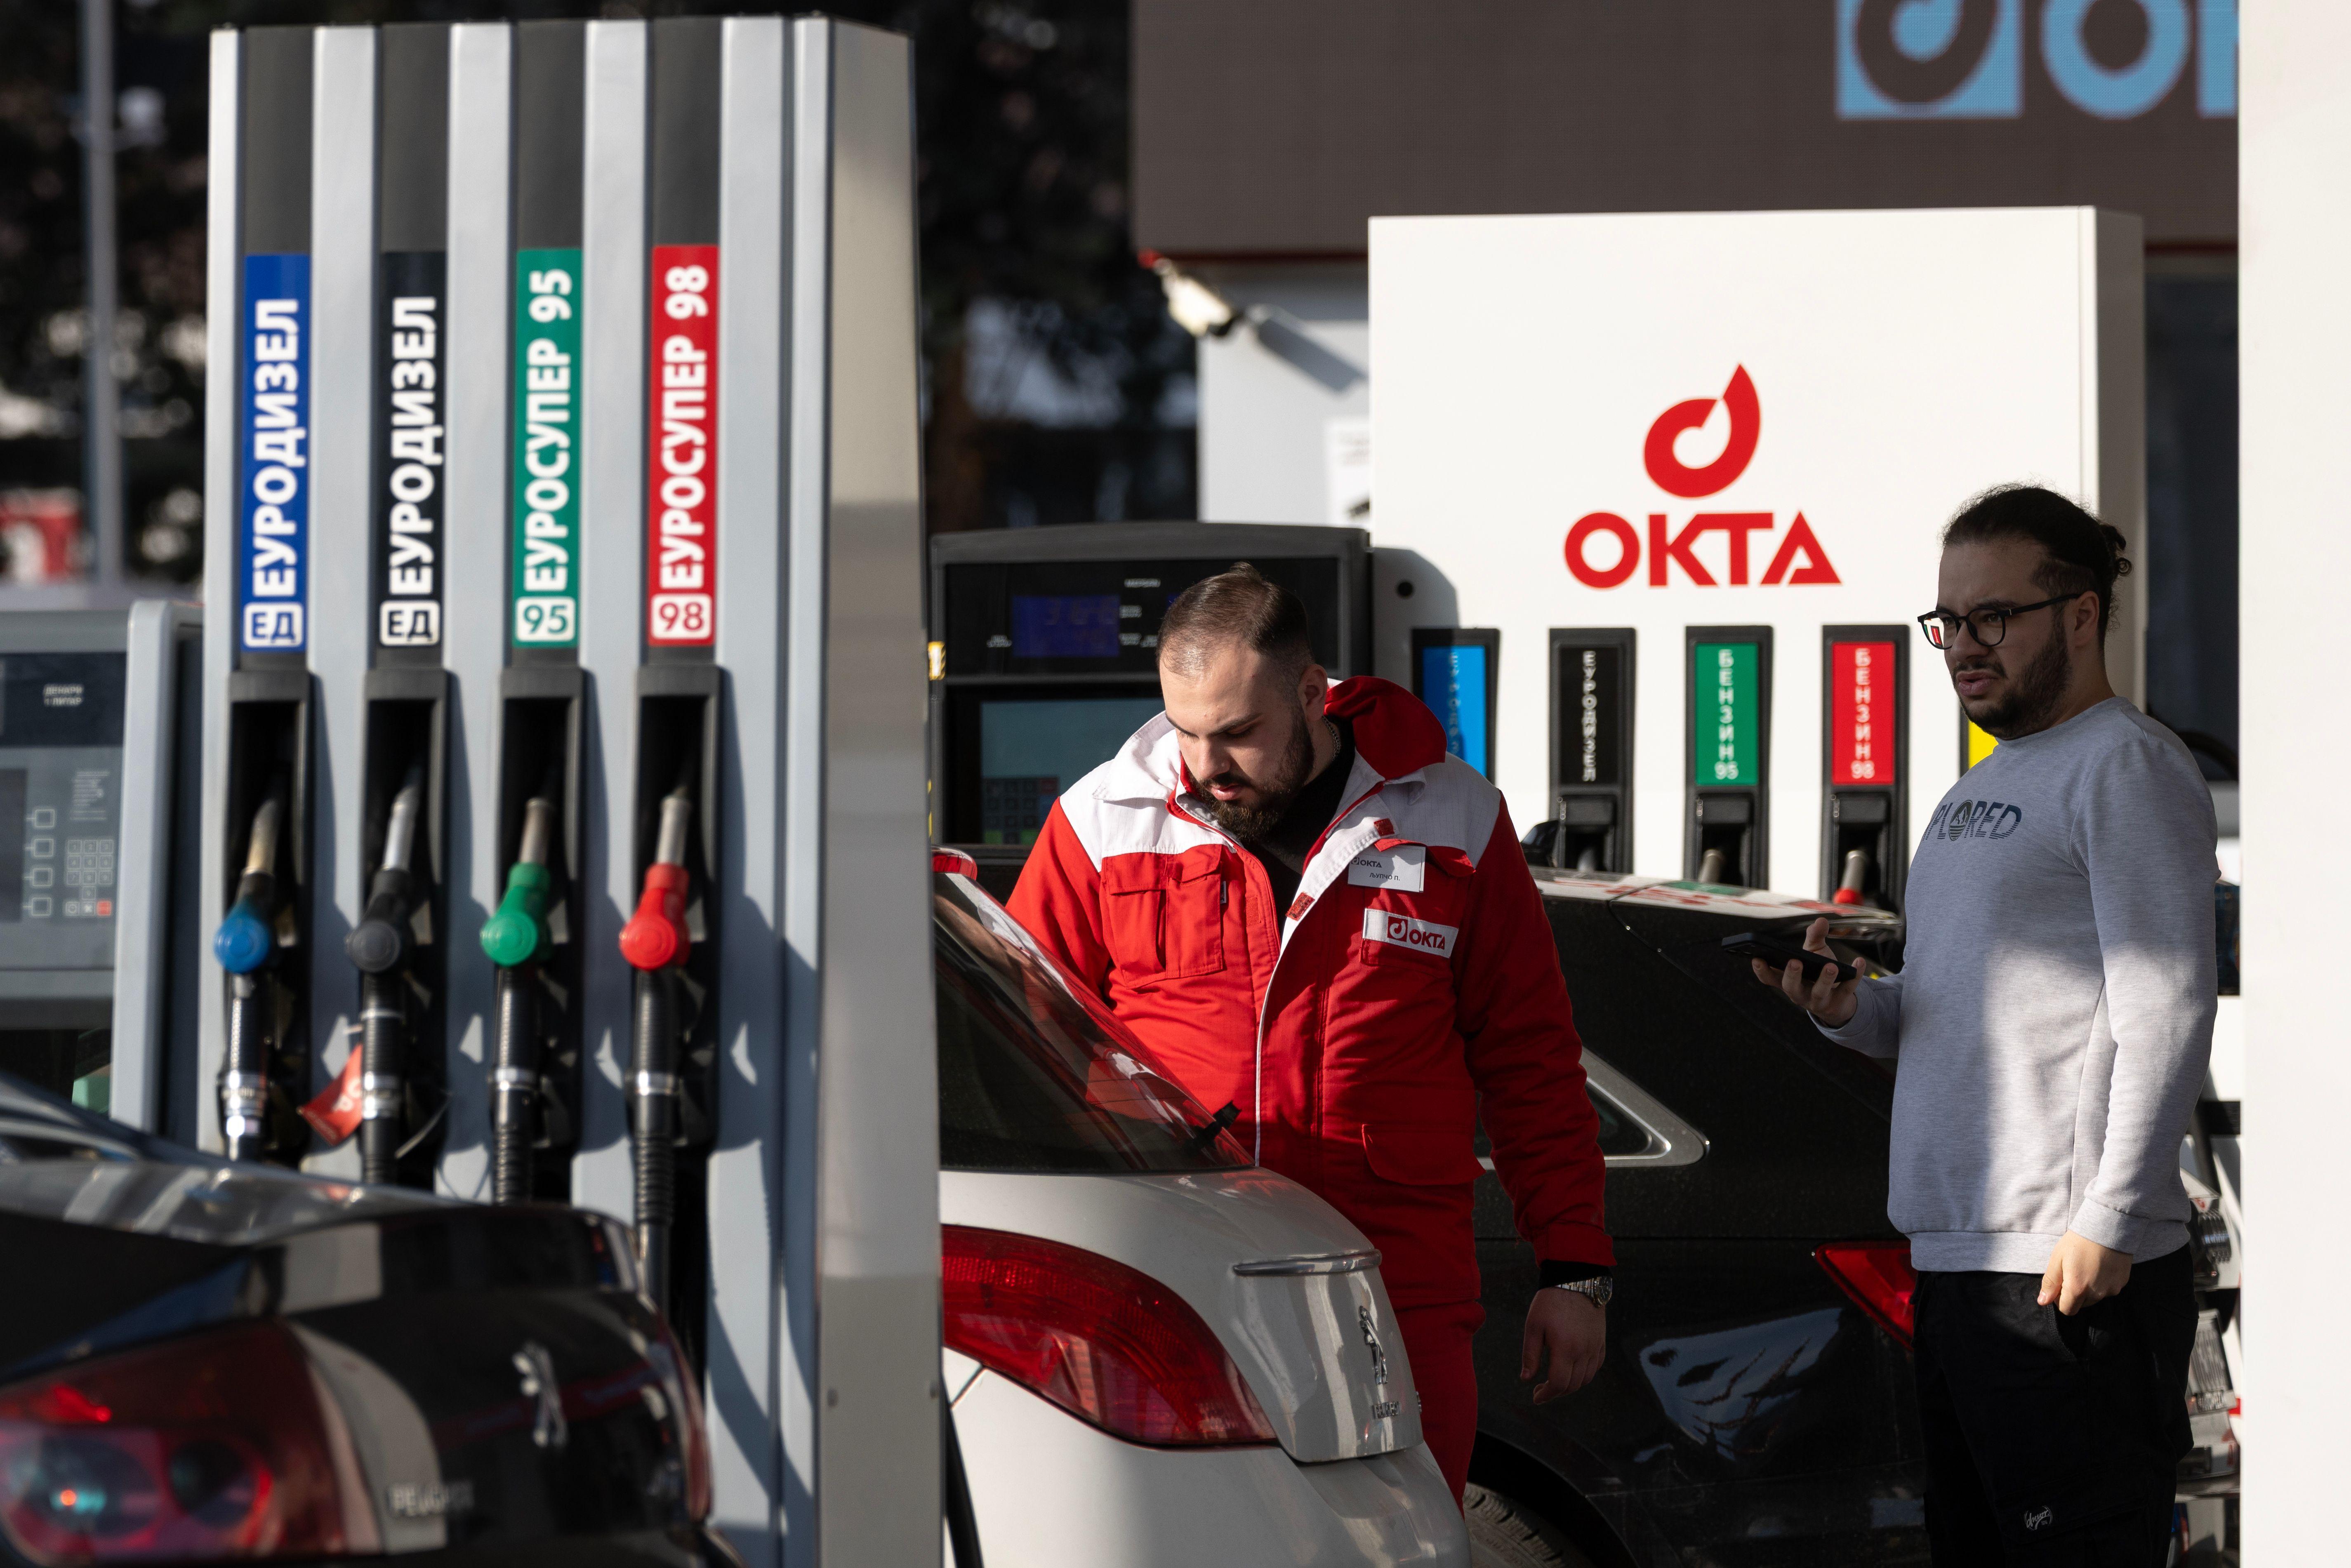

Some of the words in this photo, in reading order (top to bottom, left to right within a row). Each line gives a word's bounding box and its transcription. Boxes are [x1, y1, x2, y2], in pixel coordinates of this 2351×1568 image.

[529, 270, 571, 322] 95
[665, 265, 708, 319] 98
[253, 299, 305, 596] ЕУРОДИЗЕЛ
[389, 297, 443, 595] ЕУРОДИЗЕЛ
[525, 339, 570, 591] ЕУРОСУПЕР
[660, 335, 706, 589] ЕУРОСУПЕР
[253, 613, 294, 640] ЕД
[389, 611, 431, 638] ЕД
[524, 606, 567, 633] 95
[660, 603, 702, 630] 98
[1718, 649, 1734, 760] БЕНЗИН
[1855, 648, 1870, 759] БЕНЗИН
[1715, 761, 1739, 779] 95
[1851, 760, 1875, 779] 98
